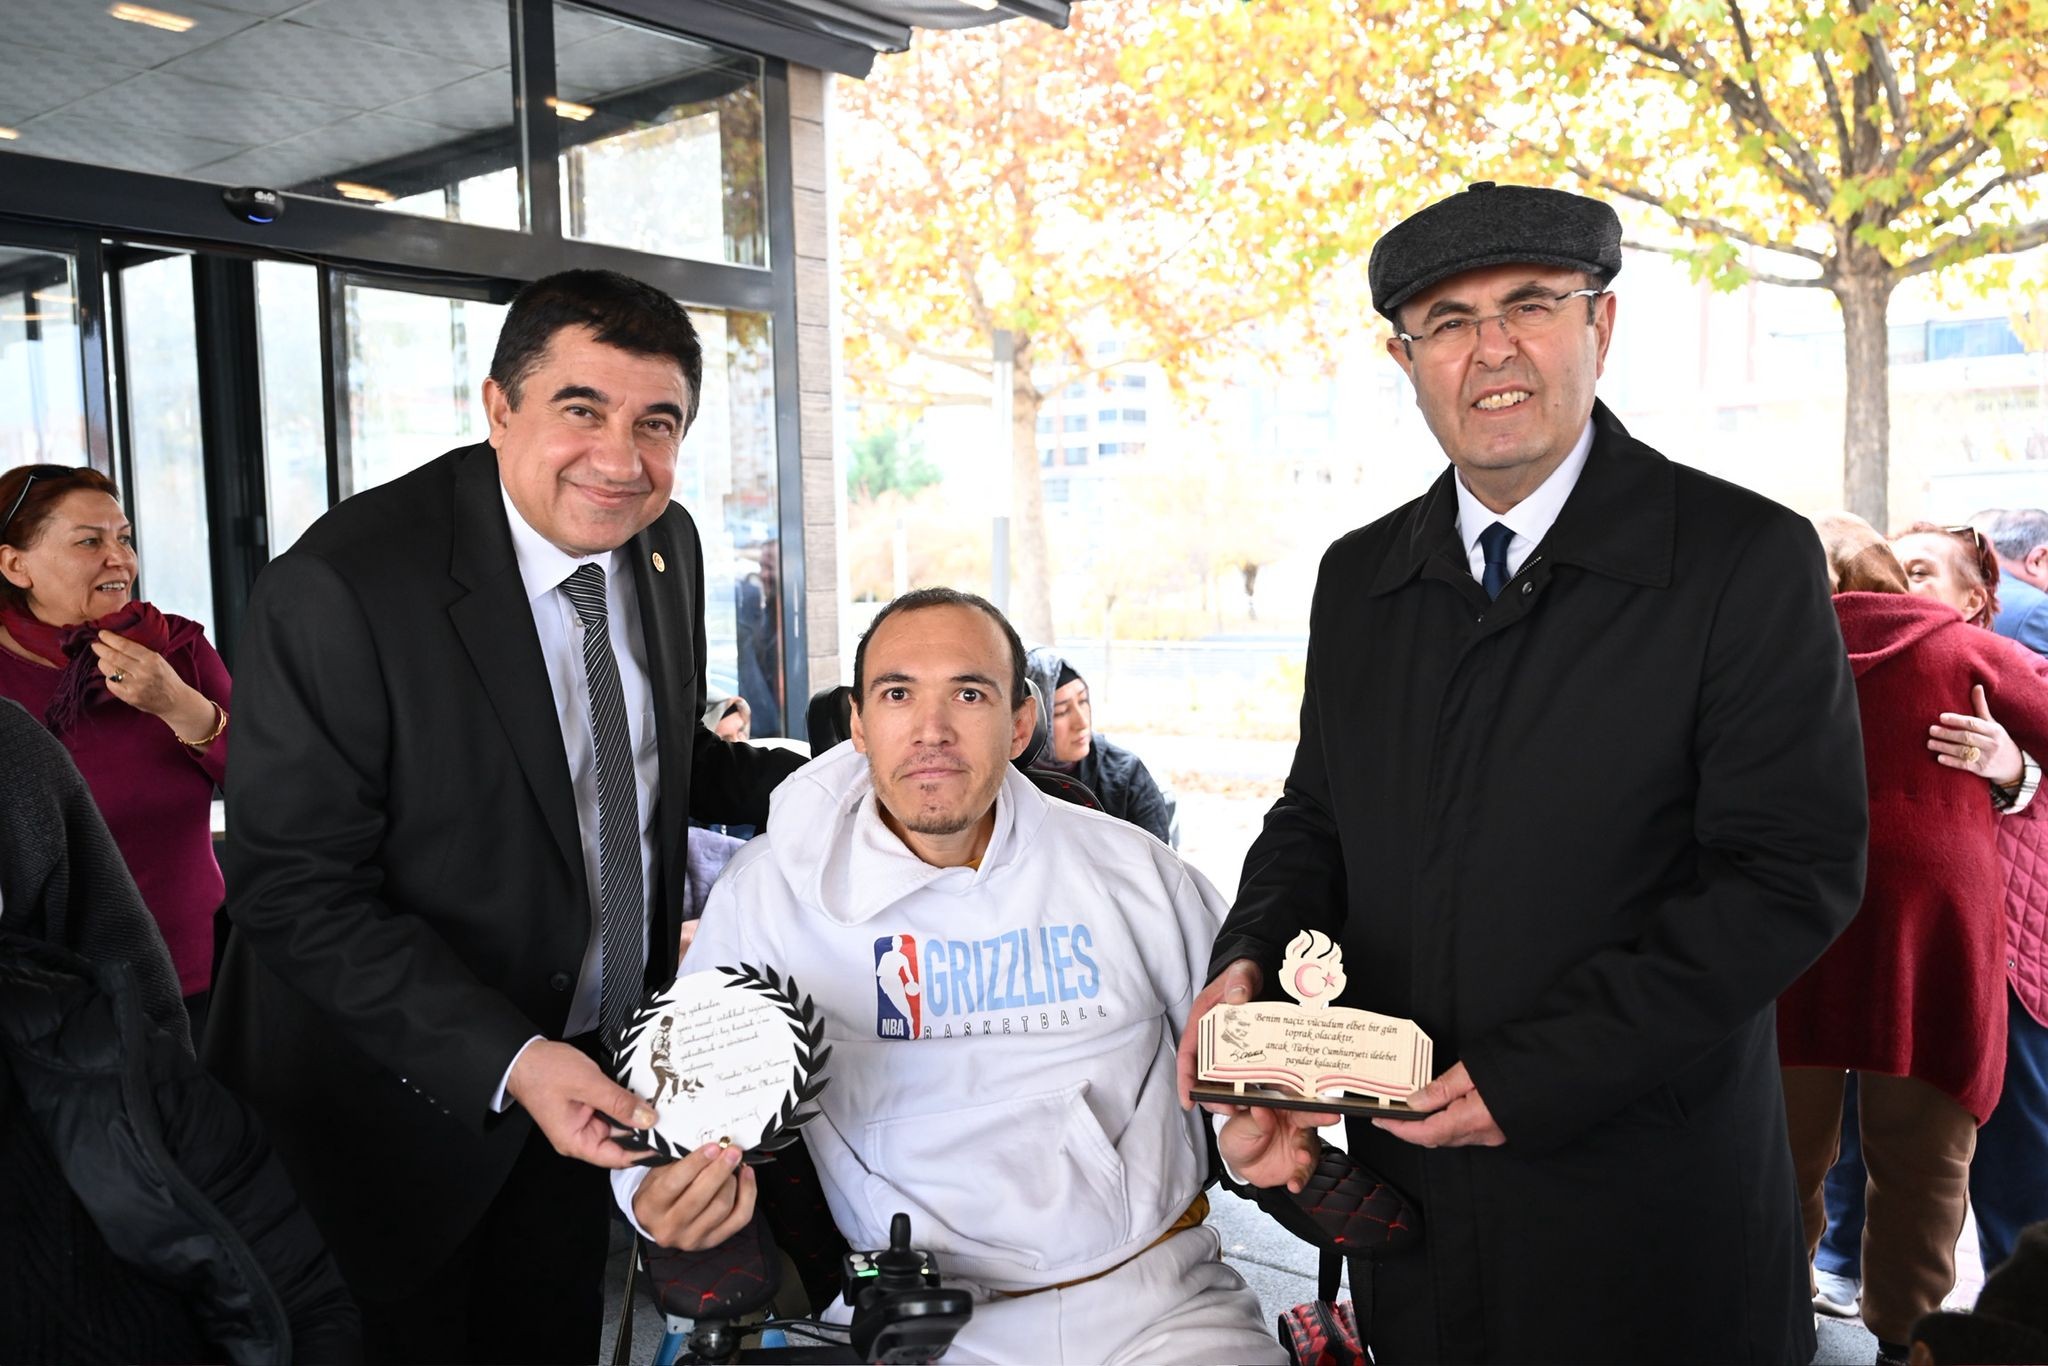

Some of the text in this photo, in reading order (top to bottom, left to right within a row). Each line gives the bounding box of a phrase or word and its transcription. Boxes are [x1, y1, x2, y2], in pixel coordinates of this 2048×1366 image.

[923, 924, 1100, 1017] GRIZZLIES
[881, 1018, 904, 1036] NBA
[924, 1005, 1107, 1039] BASKETBALL
[1255, 1013, 1281, 1023] Benim
[1307, 1018, 1344, 1029] vücudum
[1346, 1020, 1366, 1031] elbet
[1380, 1025, 1398, 1036] gün
[1285, 1029, 1315, 1040] toprak
[1265, 1041, 1289, 1053] ancak
[1292, 1042, 1320, 1056] Türkiye
